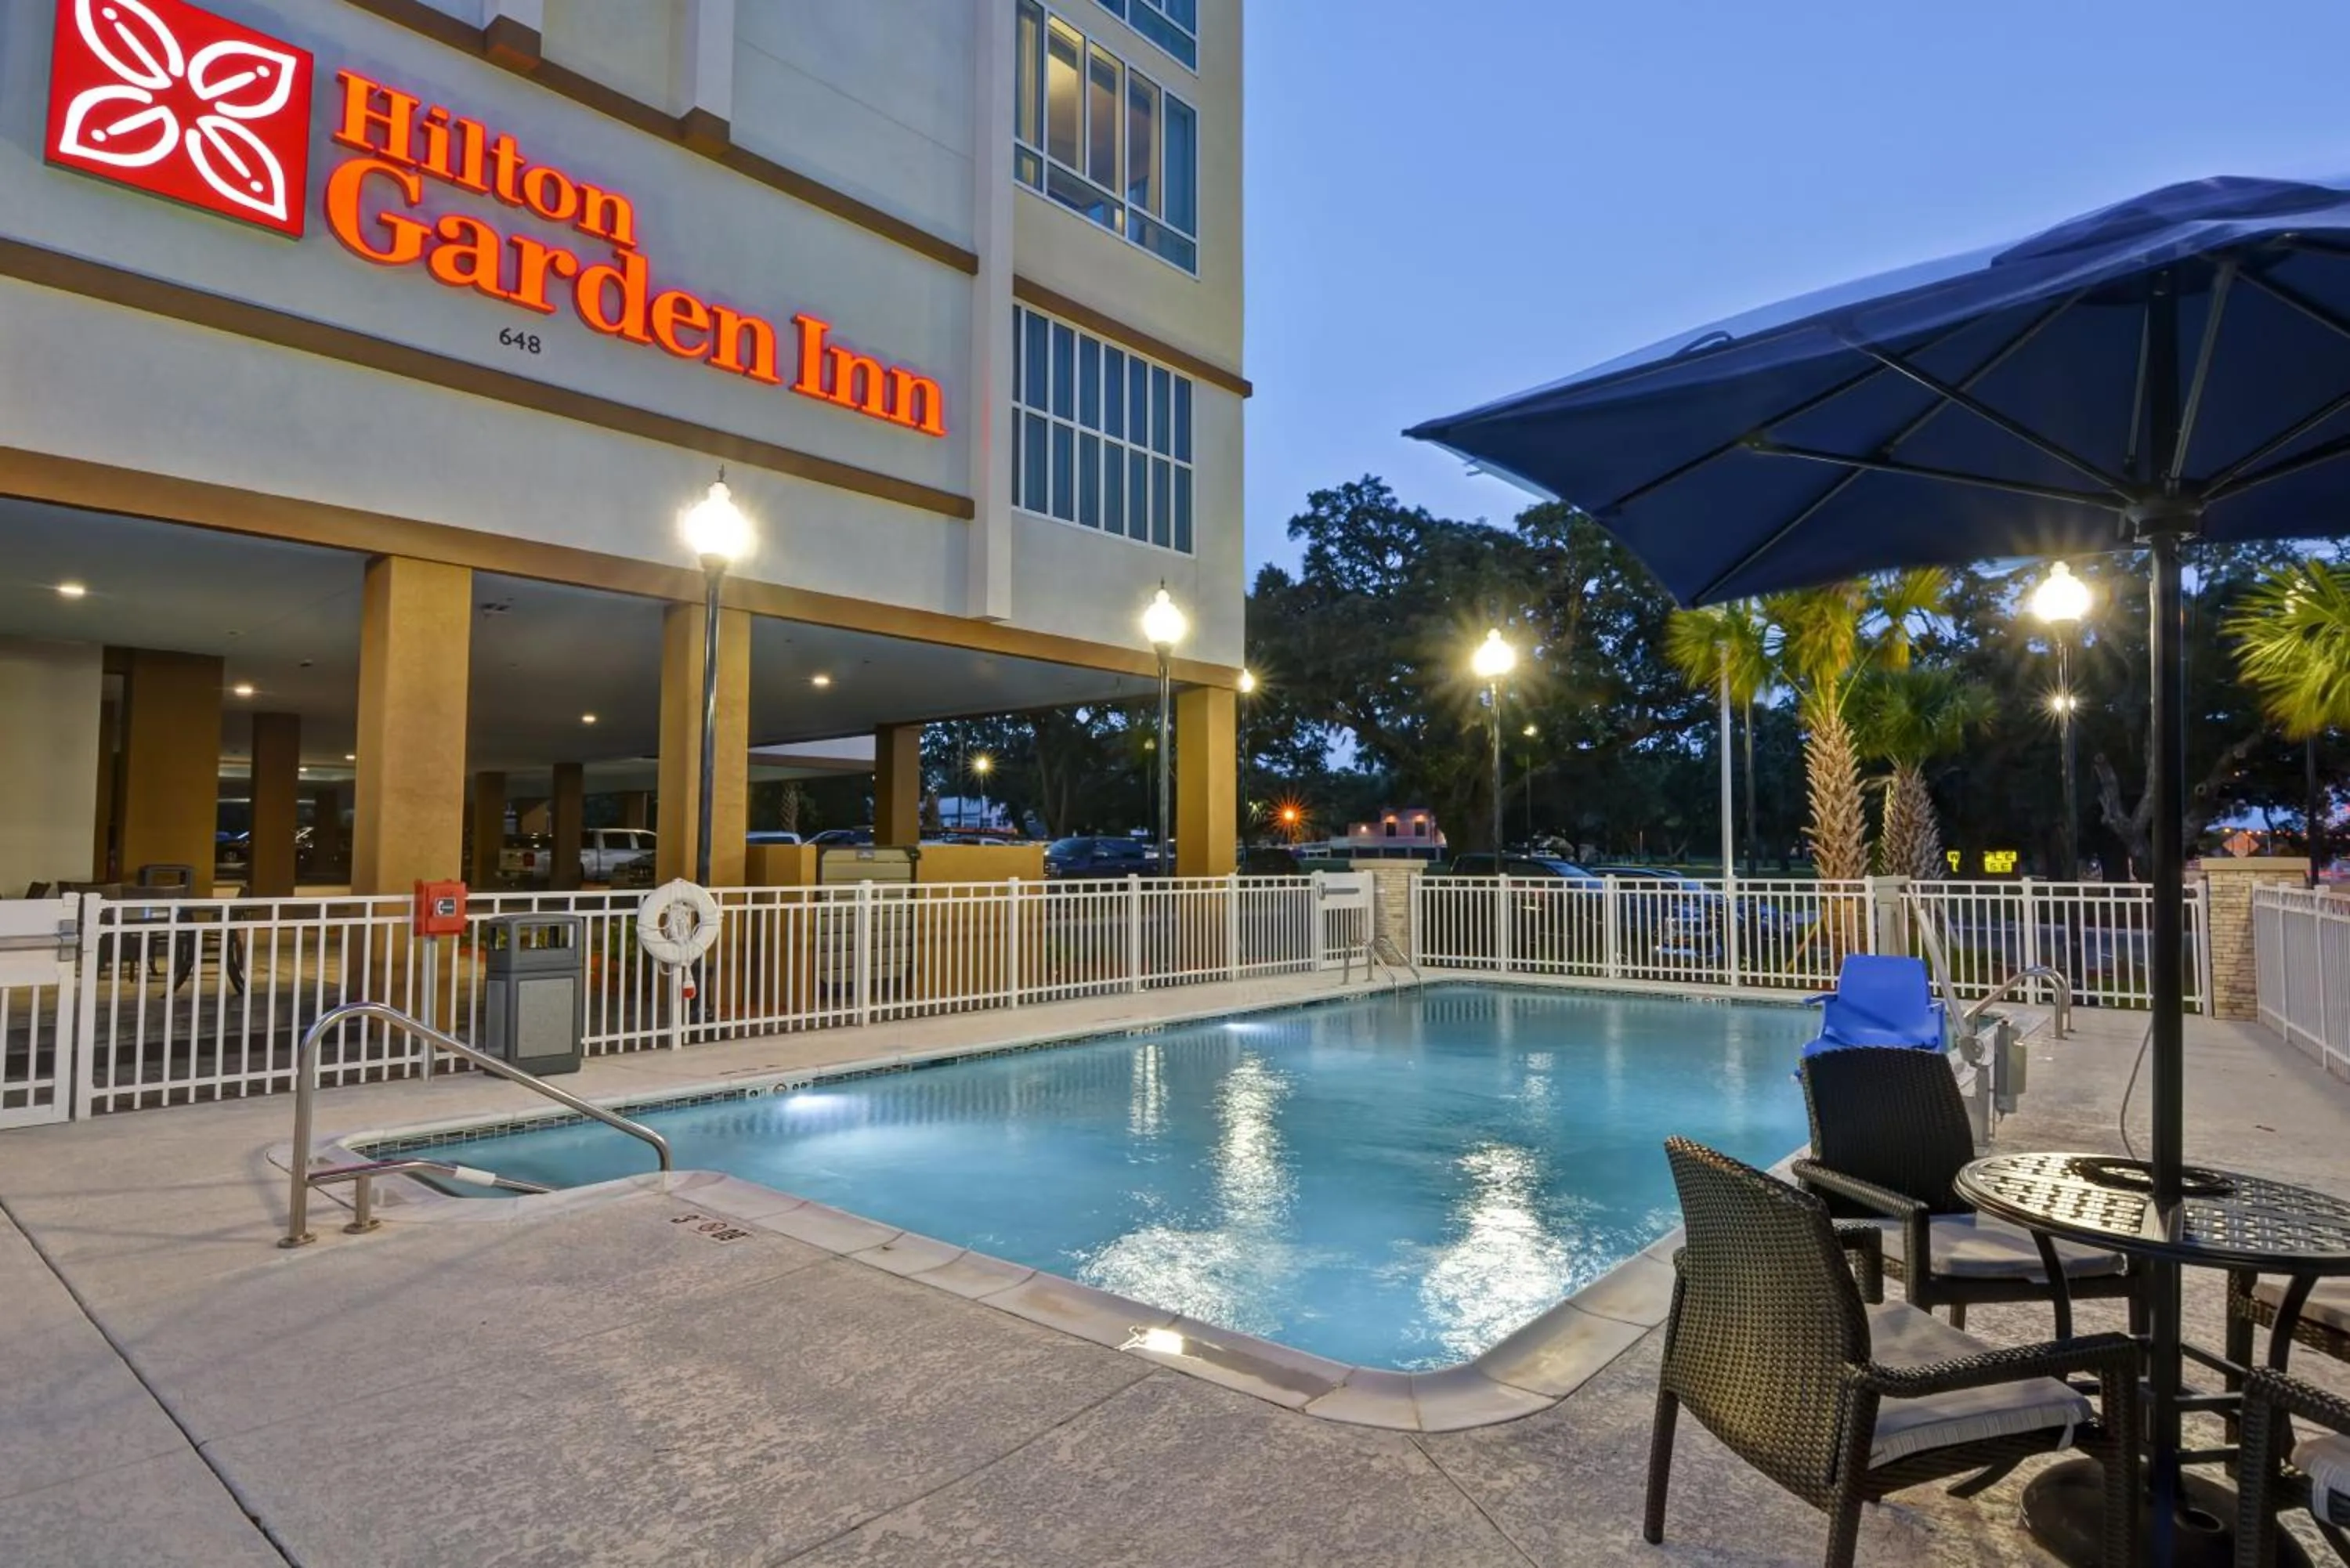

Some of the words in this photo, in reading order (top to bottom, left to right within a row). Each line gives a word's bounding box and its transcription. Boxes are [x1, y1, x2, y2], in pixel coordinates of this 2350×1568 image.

[331, 68, 637, 248] Hilton
[324, 157, 782, 385] Garden
[788, 313, 948, 437] Inn
[499, 327, 541, 354] 648
